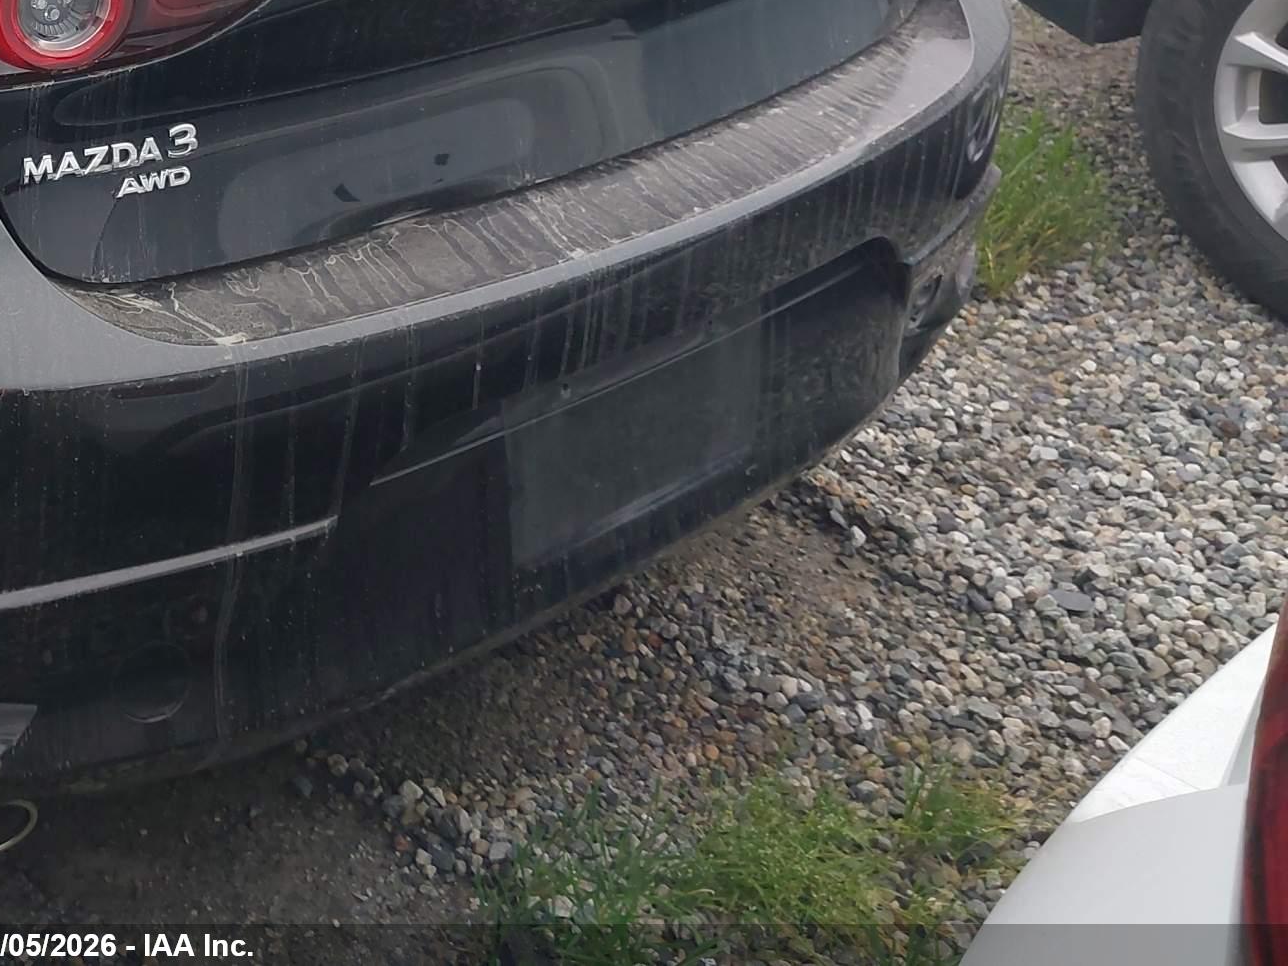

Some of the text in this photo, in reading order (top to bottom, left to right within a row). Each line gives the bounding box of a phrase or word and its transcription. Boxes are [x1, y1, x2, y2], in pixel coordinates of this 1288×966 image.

[23, 123, 198, 184] MAZDA 3
[116, 166, 191, 198] AWD
